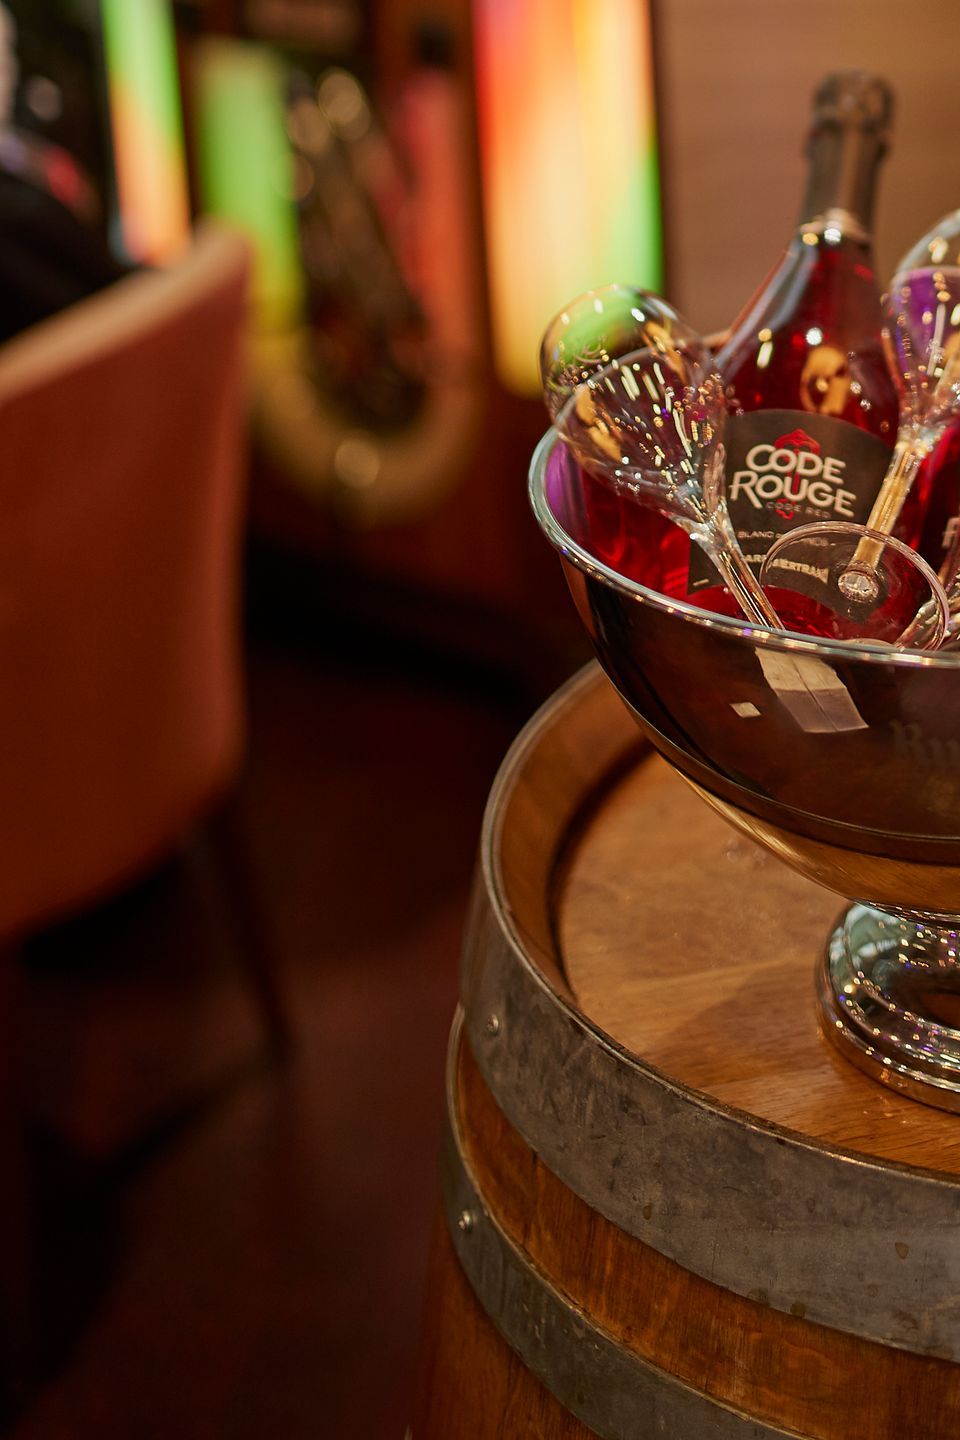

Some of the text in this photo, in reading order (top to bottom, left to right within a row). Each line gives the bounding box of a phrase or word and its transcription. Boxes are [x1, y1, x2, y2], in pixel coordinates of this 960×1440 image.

[746, 444, 846, 485] CODE
[729, 471, 857, 517] ROUGE
[737, 530, 775, 539] BLANC
